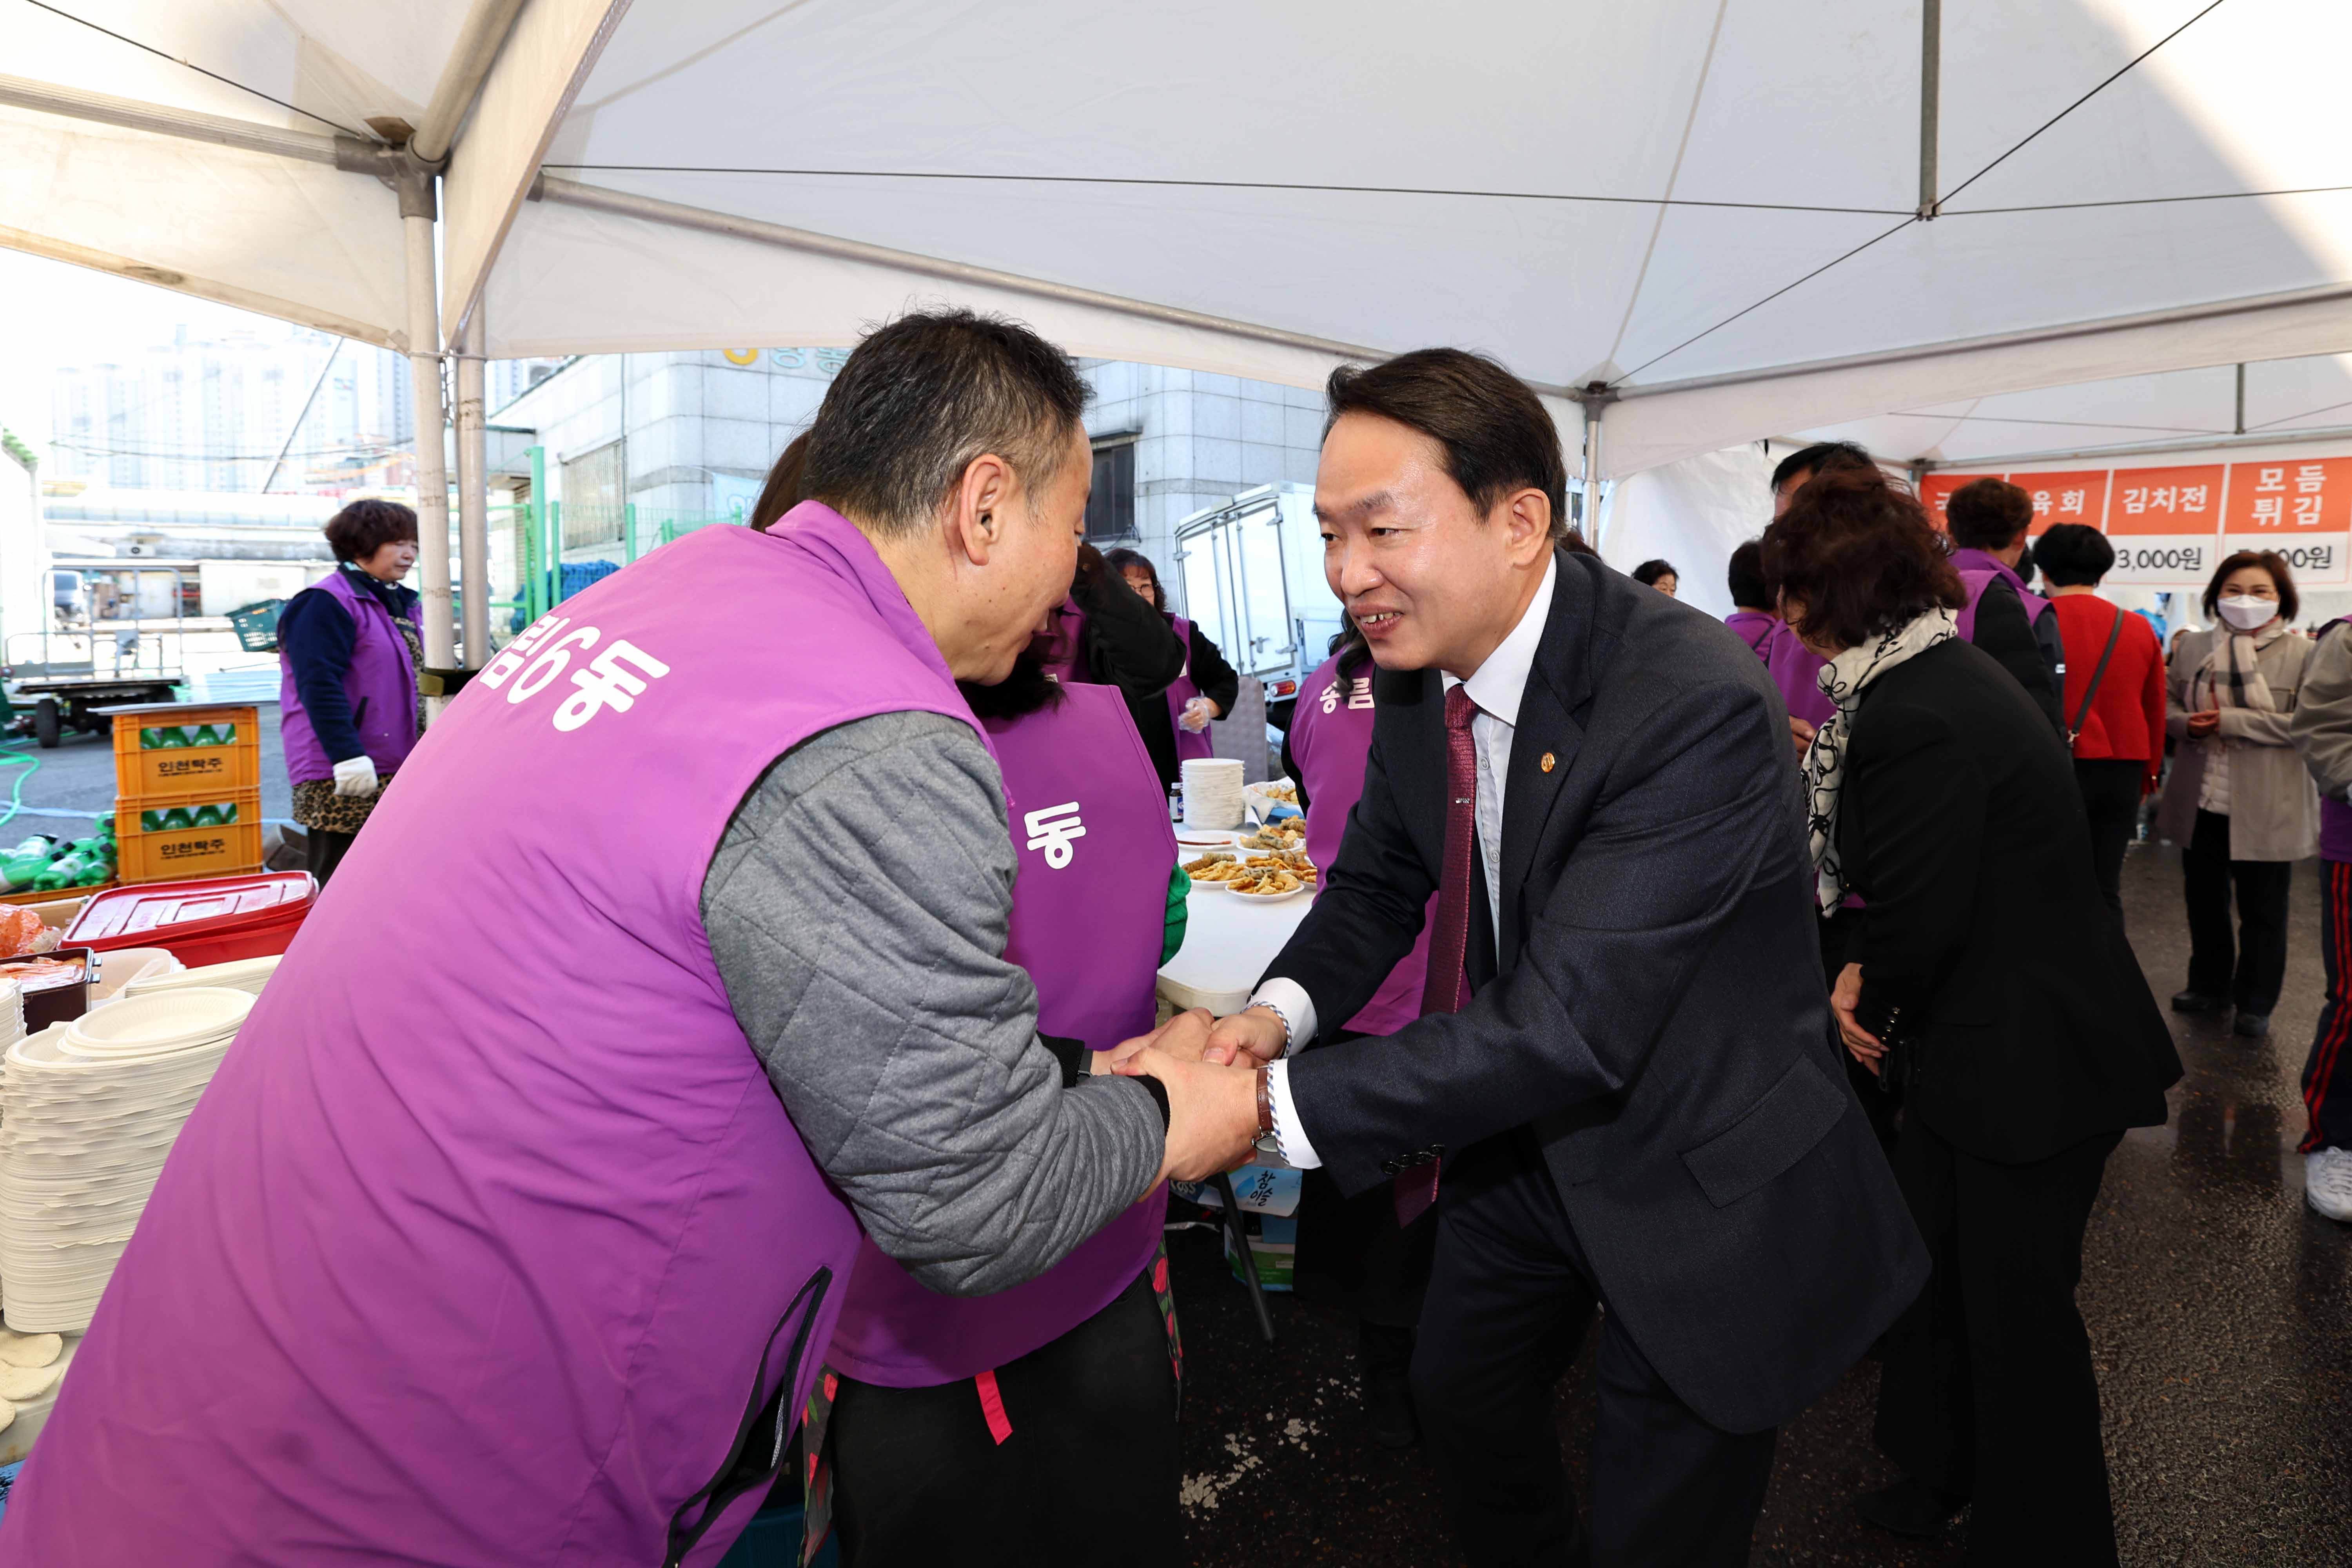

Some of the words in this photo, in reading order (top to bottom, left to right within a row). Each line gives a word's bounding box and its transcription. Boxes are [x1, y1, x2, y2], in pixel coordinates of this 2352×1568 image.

[2255, 465, 2327, 493] 모듬
[2122, 485, 2208, 514] 김치전
[2251, 495, 2322, 526] 튀김
[2118, 547, 2202, 571] 3,000원
[477, 614, 670, 732] 림6동
[1024, 801, 1087, 869] 동
